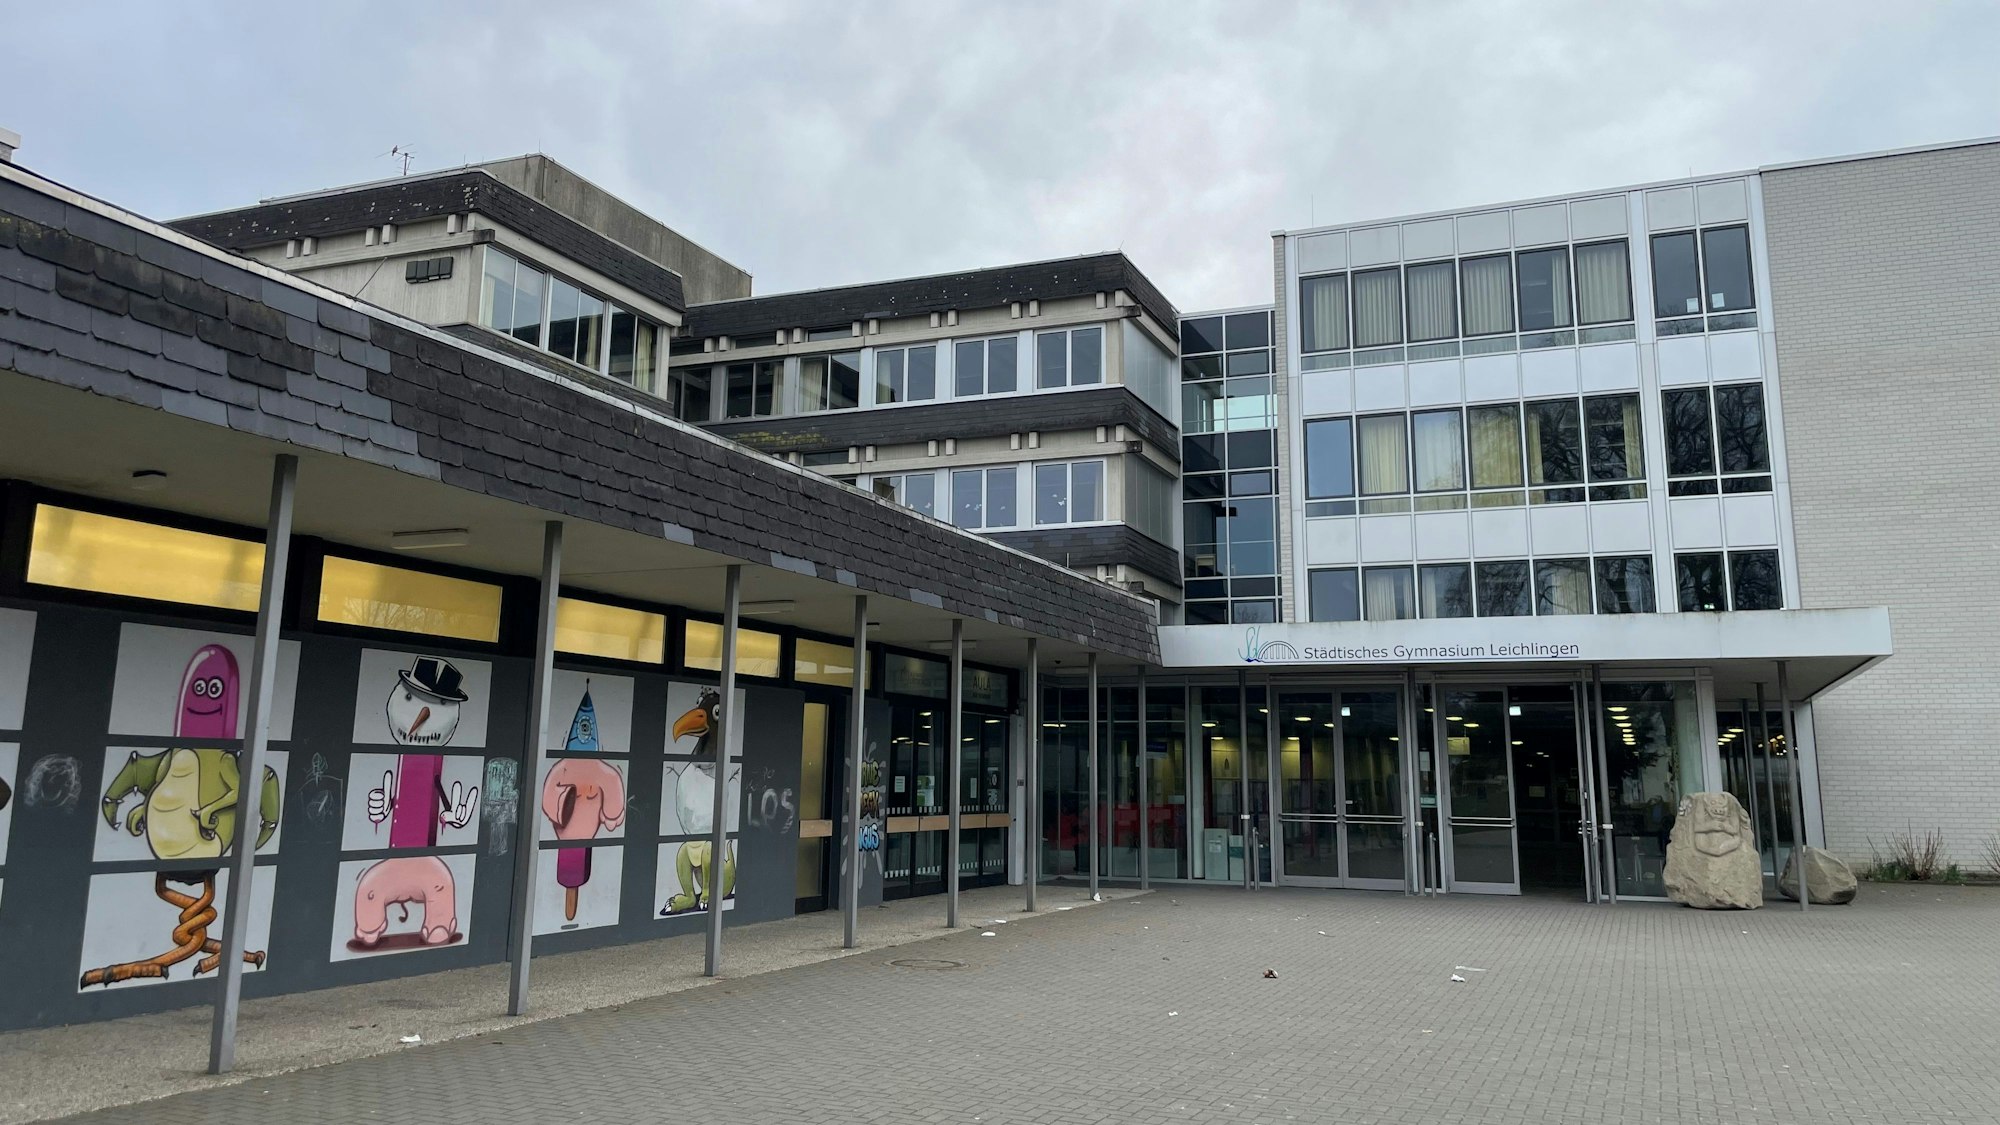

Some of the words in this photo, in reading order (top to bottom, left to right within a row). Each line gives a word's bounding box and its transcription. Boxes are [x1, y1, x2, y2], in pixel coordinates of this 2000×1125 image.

[1304, 646, 1389, 660] Städtisches
[1393, 644, 1485, 661] Gymnasium
[1490, 642, 1579, 659] Leichlingen
